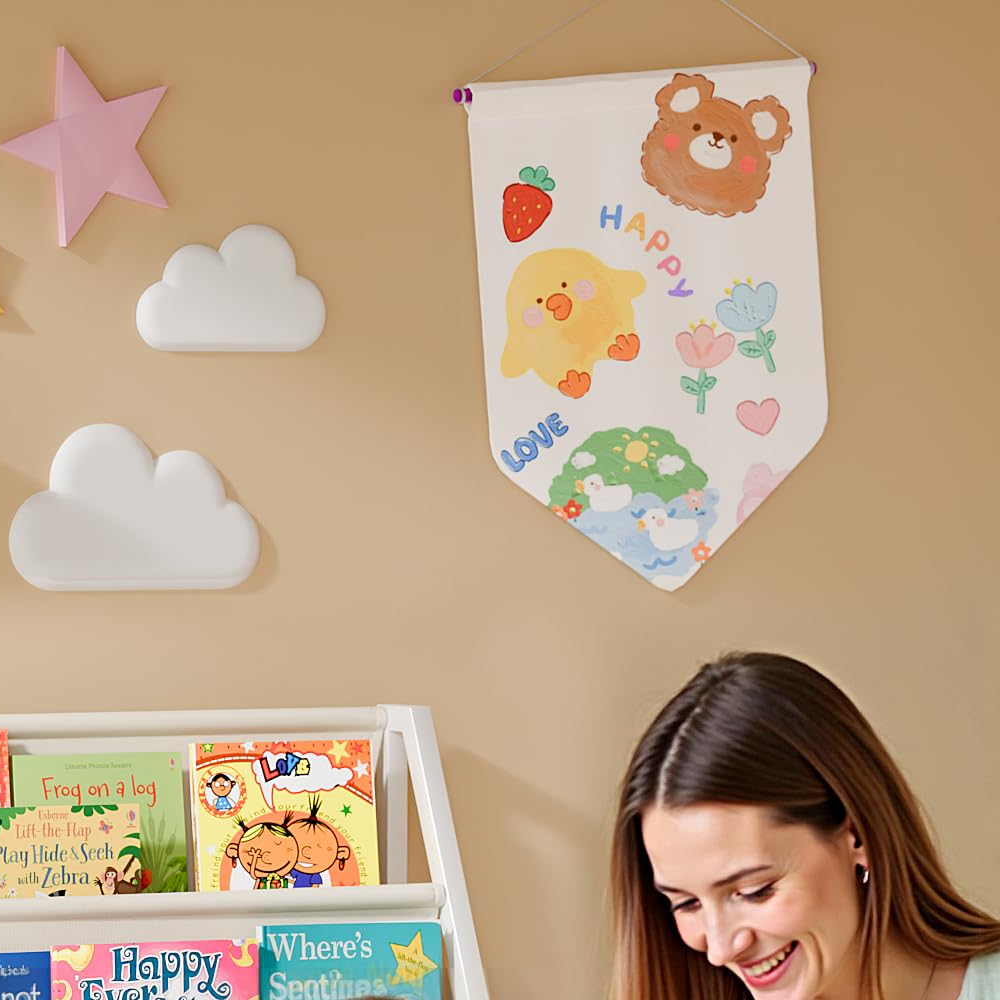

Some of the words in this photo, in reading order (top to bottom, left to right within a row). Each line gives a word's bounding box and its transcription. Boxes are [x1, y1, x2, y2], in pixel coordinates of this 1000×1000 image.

[600, 204, 693, 297] HAPPY
[501, 412, 569, 472] LOVE
[42, 774, 81, 806] Frog
[87, 783, 109, 798] on
[116, 781, 125, 797] a
[131, 774, 157, 807] log
[31, 843, 68, 864] Hide
[80, 842, 114, 864] Seek
[18, 872, 39, 885] with
[41, 865, 90, 888] Zebra
[266, 931, 372, 962] Where's
[111, 946, 232, 1000] Happy
